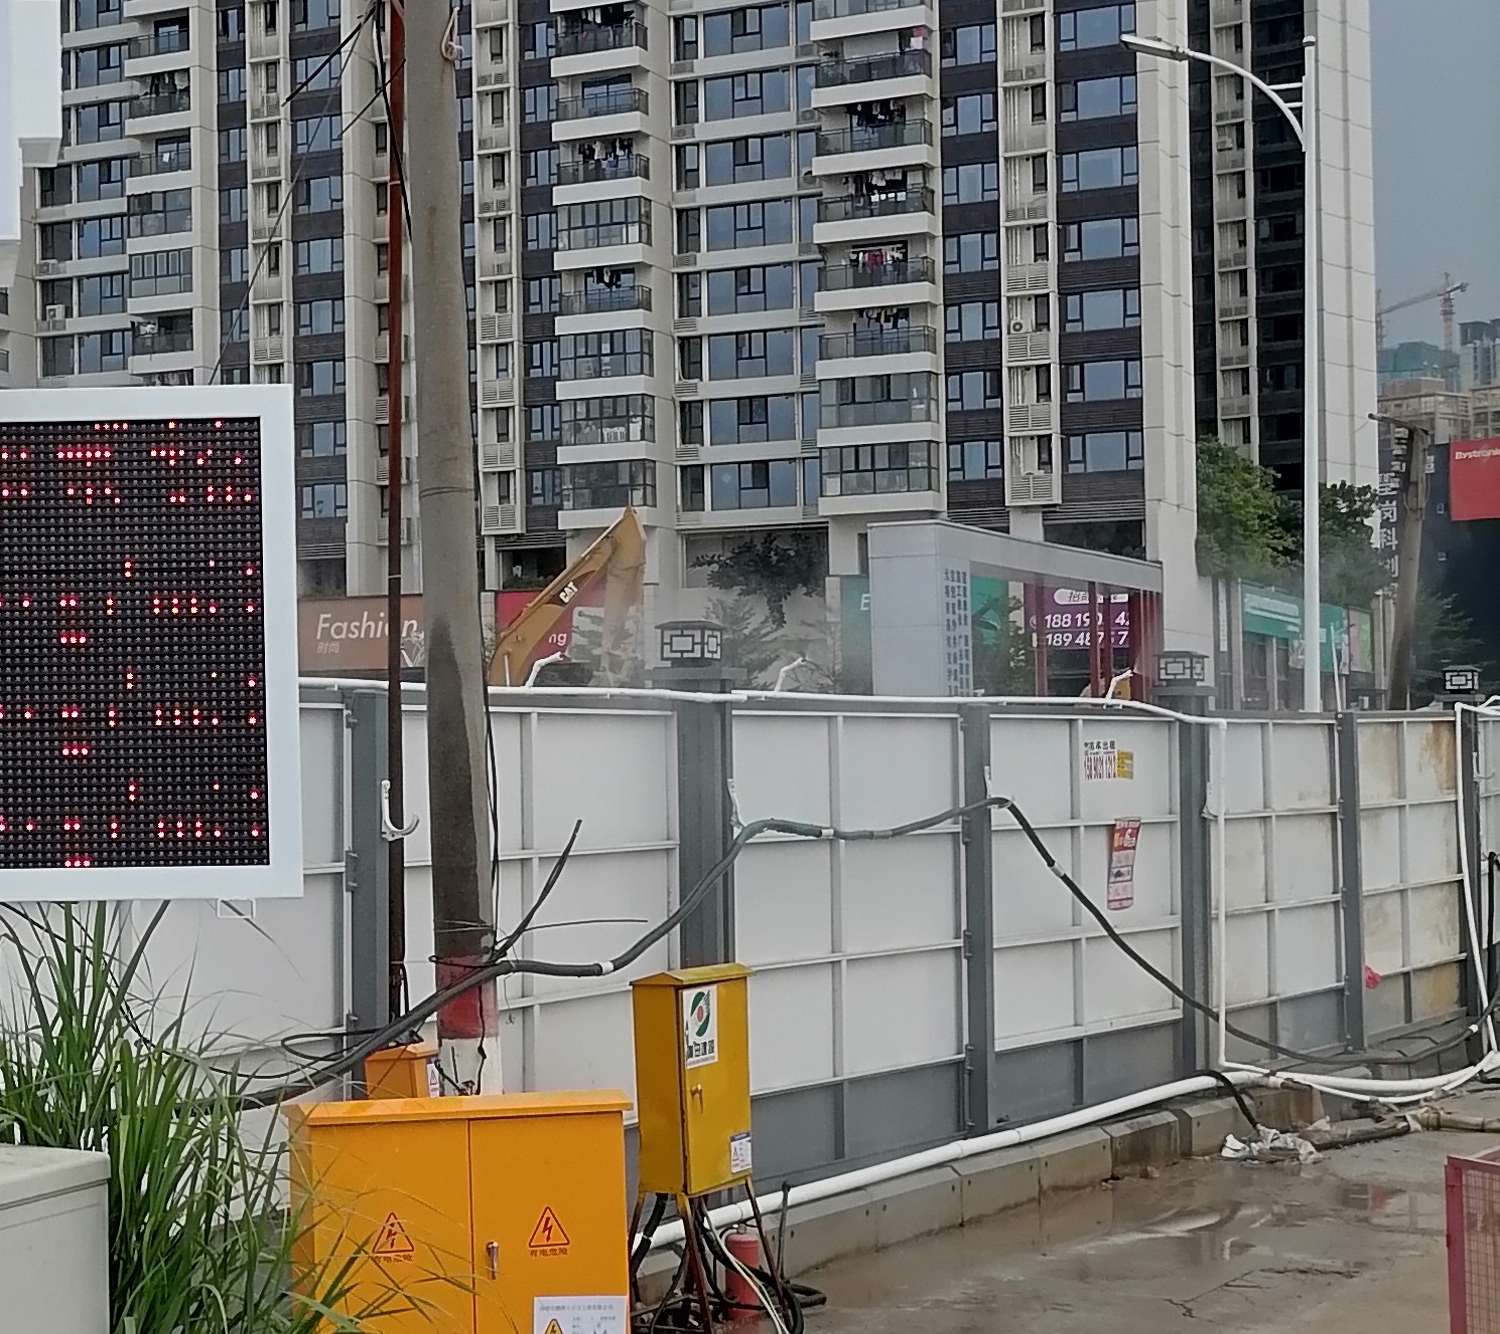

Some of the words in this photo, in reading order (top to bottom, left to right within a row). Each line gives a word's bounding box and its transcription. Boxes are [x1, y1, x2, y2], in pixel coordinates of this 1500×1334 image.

[559, 581, 579, 604] CAT
[316, 611, 418, 640] Fashin
[529, 1248, 568, 1258] 有电危险
